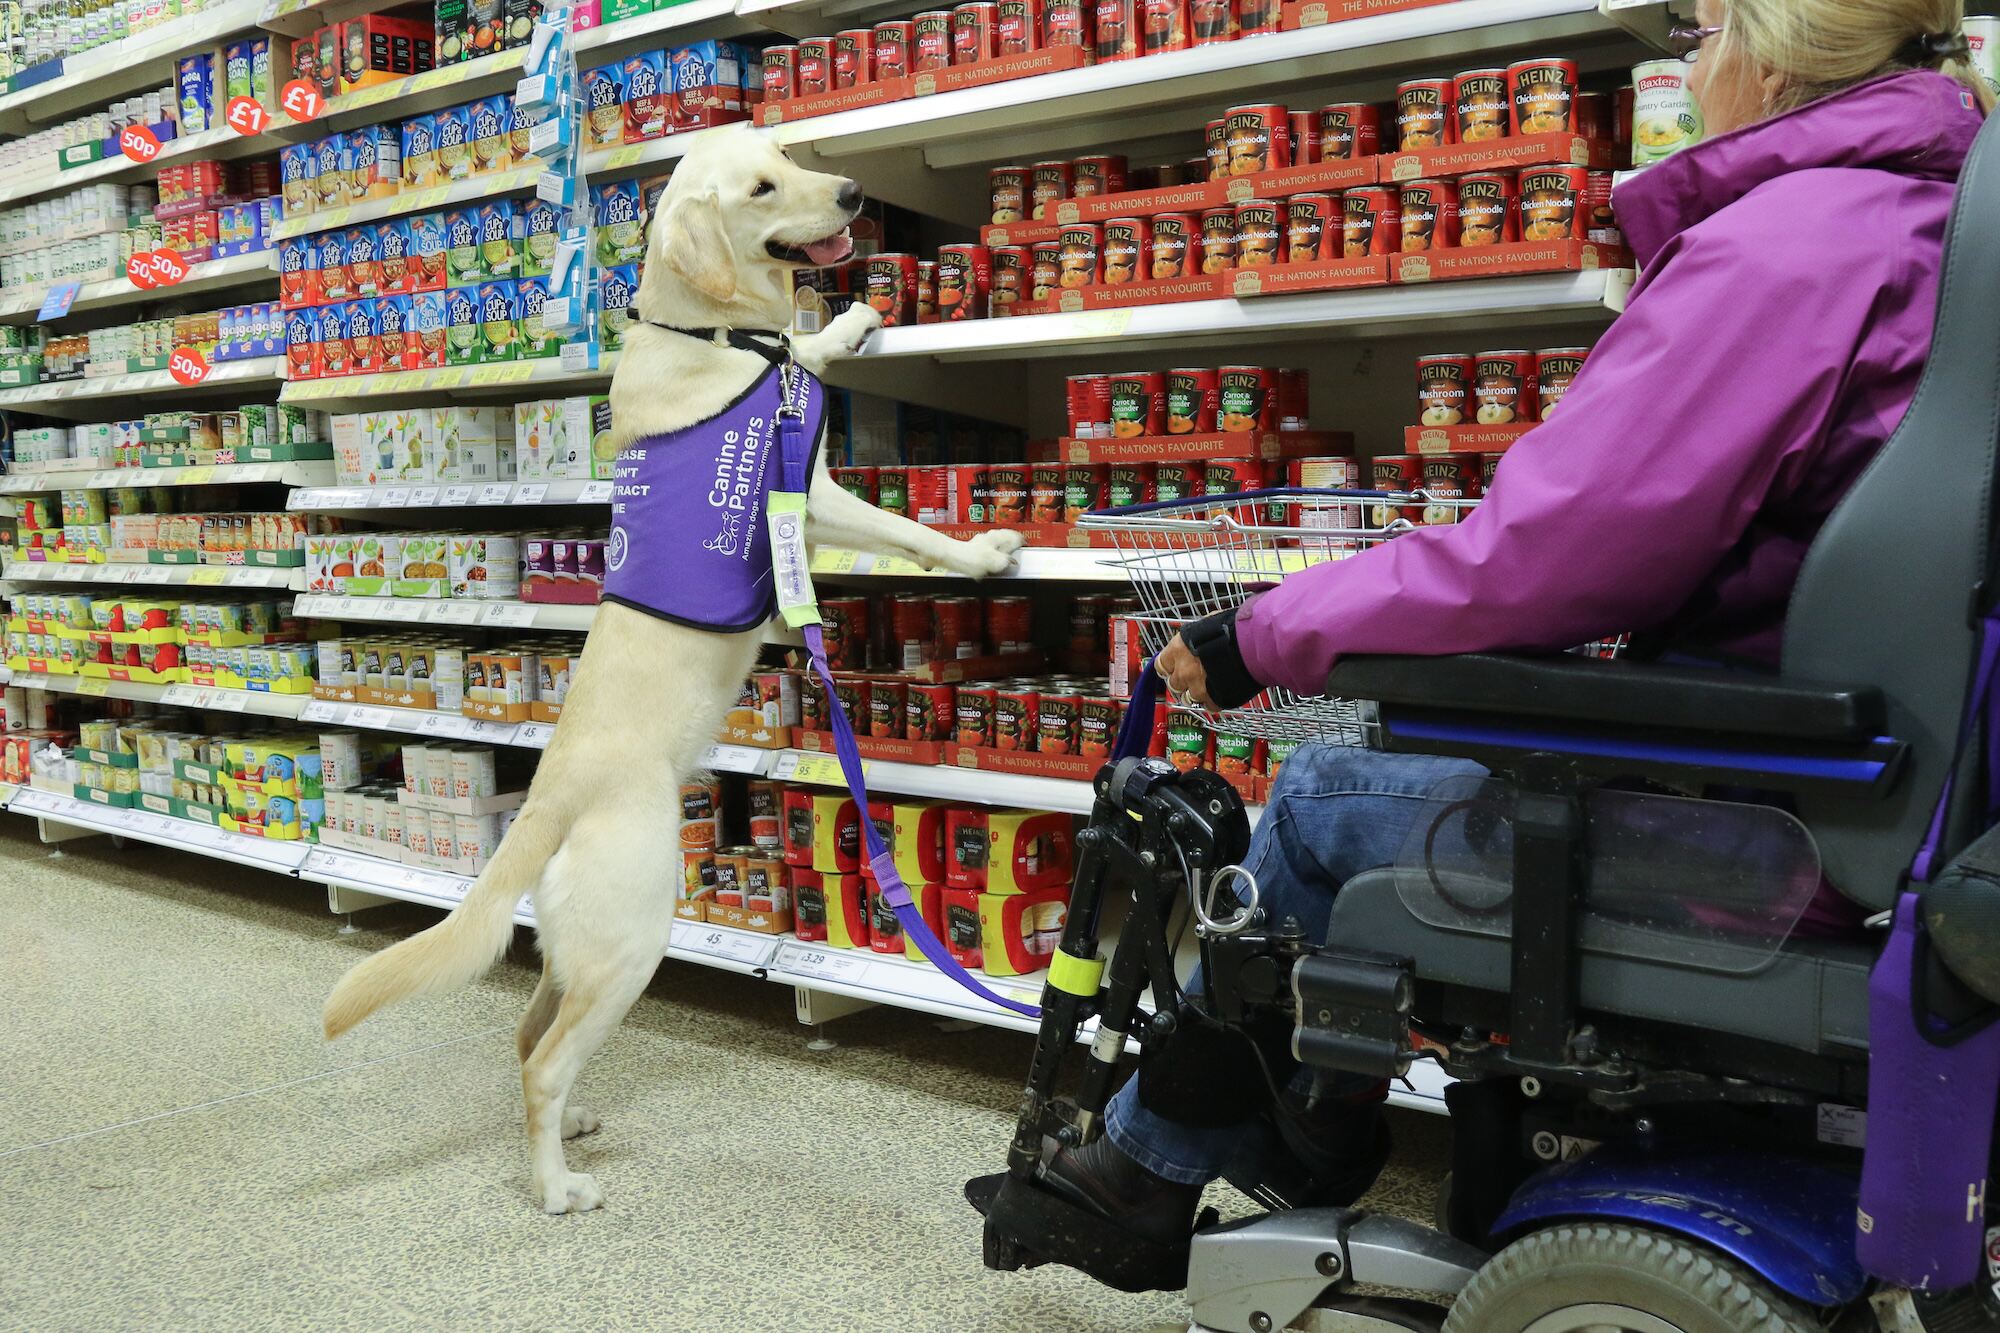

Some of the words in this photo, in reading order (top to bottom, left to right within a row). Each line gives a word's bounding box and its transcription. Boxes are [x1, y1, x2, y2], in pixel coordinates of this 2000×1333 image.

[1097, 3, 1117, 16] Oxtail
[1342, 2, 1362, 12] THE
[1051, 12, 1076, 22] Oxtail
[916, 20, 947, 34] HEINZ
[1000, 23, 1019, 33] Oxtail
[919, 38, 942, 47] Oxtail
[877, 46, 896, 56] Oxtail
[227, 57, 247, 71] QUICK
[253, 52, 269, 65] QUIC
[254, 64, 268, 76] SOA
[800, 63, 817, 73] Oxtail
[946, 72, 962, 84] THE
[964, 65, 1003, 81] NATION'S
[1006, 55, 1052, 73] FAVOURITE
[229, 68, 246, 81] SOAK
[764, 70, 781, 80] Oxtail
[1519, 69, 1564, 86] HEINZ
[680, 75, 706, 89] SOUP
[1640, 78, 1680, 90] Baxters
[632, 84, 656, 98] SOUP
[1462, 82, 1503, 95] HEINZ
[284, 87, 317, 117] £1
[593, 93, 615, 106] SOUP
[636, 99, 649, 108] BEEF
[683, 96, 705, 106] TOMATO
[792, 105, 805, 114] THE
[807, 96, 841, 111] NATION'S
[843, 88, 884, 104] FAVOURITE
[1400, 90, 1437, 106] HEINZ
[1515, 94, 1543, 104] Chicken
[1544, 92, 1570, 101] Noodle
[1458, 103, 1483, 114] Chicken
[1483, 102, 1510, 111] Noodle
[1634, 103, 1658, 112] ountry
[1661, 100, 1691, 108] Garden
[229, 101, 263, 129] £1
[1417, 111, 1444, 122] Noodle
[1226, 114, 1262, 130] HEINZ
[477, 126, 498, 138] SOUP
[122, 131, 156, 157] 50p
[442, 134, 462, 147] SOUP
[1248, 134, 1267, 144] Noodle
[413, 143, 429, 155] SOUP
[1430, 156, 1447, 166] THE
[1450, 150, 1494, 164] NATION'S
[1497, 143, 1546, 157] FAVOURITE
[991, 174, 1020, 187] HEINZ
[1261, 180, 1276, 189] THE
[1278, 174, 1317, 187] NATION'S
[1319, 167, 1364, 181] FAVOURITE
[1524, 176, 1569, 193] HEINZ
[992, 193, 1019, 202] Chicken
[1032, 188, 1057, 198] Chicken
[1460, 184, 1500, 199] HEINZ
[1091, 203, 1106, 212] THE
[1109, 198, 1152, 210] NATION'S
[1155, 191, 1204, 206] FAVOURITE
[1521, 200, 1544, 210] Chicken
[1545, 198, 1573, 208] Noodle
[609, 210, 634, 224] SOUP
[1458, 207, 1477, 217] Chicken
[1477, 205, 1503, 214] Noodle
[1237, 210, 1273, 225] HEINZ
[532, 220, 553, 232] SOUP
[453, 234, 472, 245] SOUP
[485, 228, 505, 241] SOUP
[1014, 230, 1026, 238] THE
[1060, 232, 1091, 244] HEINZ
[1254, 230, 1279, 240] Noodle
[385, 246, 402, 255] SOUP
[1077, 250, 1096, 260] Noodle
[1440, 259, 1455, 268] THE
[1459, 255, 1503, 267] NATION'S
[1506, 251, 1557, 264] FAVOURITE
[150, 254, 183, 279] 50p
[867, 275, 891, 284] Tomato
[1268, 272, 1283, 282] THE
[1284, 269, 1326, 281] NATION'S
[1328, 266, 1376, 278] FAVOURITE
[1094, 291, 1111, 301] THE
[1114, 286, 1158, 299] NATION'S
[1160, 282, 1212, 296] FAVOURITE
[606, 295, 630, 309] SOUP
[453, 310, 471, 323] SOUP
[486, 310, 507, 322] SOUP
[352, 326, 369, 337] SOUP
[172, 356, 202, 380] 50p
[1421, 367, 1461, 380] HEINZ
[1477, 363, 1513, 376] HEINZ
[1222, 375, 1256, 388] HEINZ
[1419, 389, 1464, 399] Mushroom
[1475, 386, 1517, 396] Mushroom
[1539, 385, 1569, 395] Mushr
[1222, 398, 1253, 406] Coriander
[1423, 431, 1446, 439] HEINZ
[1458, 434, 1474, 442] THE
[1478, 433, 1520, 441] NATION'S
[1100, 445, 1116, 454] THE
[1119, 443, 1163, 454] NATION'S
[1168, 440, 1224, 451] FAVOURITE
[618, 450, 646, 460] EASE
[708, 430, 739, 507] Canine
[728, 416, 763, 510] Partners
[754, 441, 772, 495] Transforming
[615, 467, 638, 478] ON'T
[614, 485, 650, 496] TRACT
[880, 490, 897, 498] Lentil
[750, 499, 760, 523] dogs.
[742, 524, 755, 561] Amazing
[876, 559, 890, 568] 95
[957, 708, 981, 717] Tomato
[1040, 716, 1067, 725] Tomato
[1081, 719, 1106, 729] Tomato
[1167, 731, 1202, 742] Vegetable
[1216, 737, 1249, 747] Vegetable
[988, 755, 1002, 764] THE
[1004, 757, 1041, 768] NATION'S
[1045, 760, 1089, 772] FAVOURITE
[798, 766, 809, 775] 95
[963, 842, 983, 850] Tomato
[955, 921, 975, 932] Tomato
